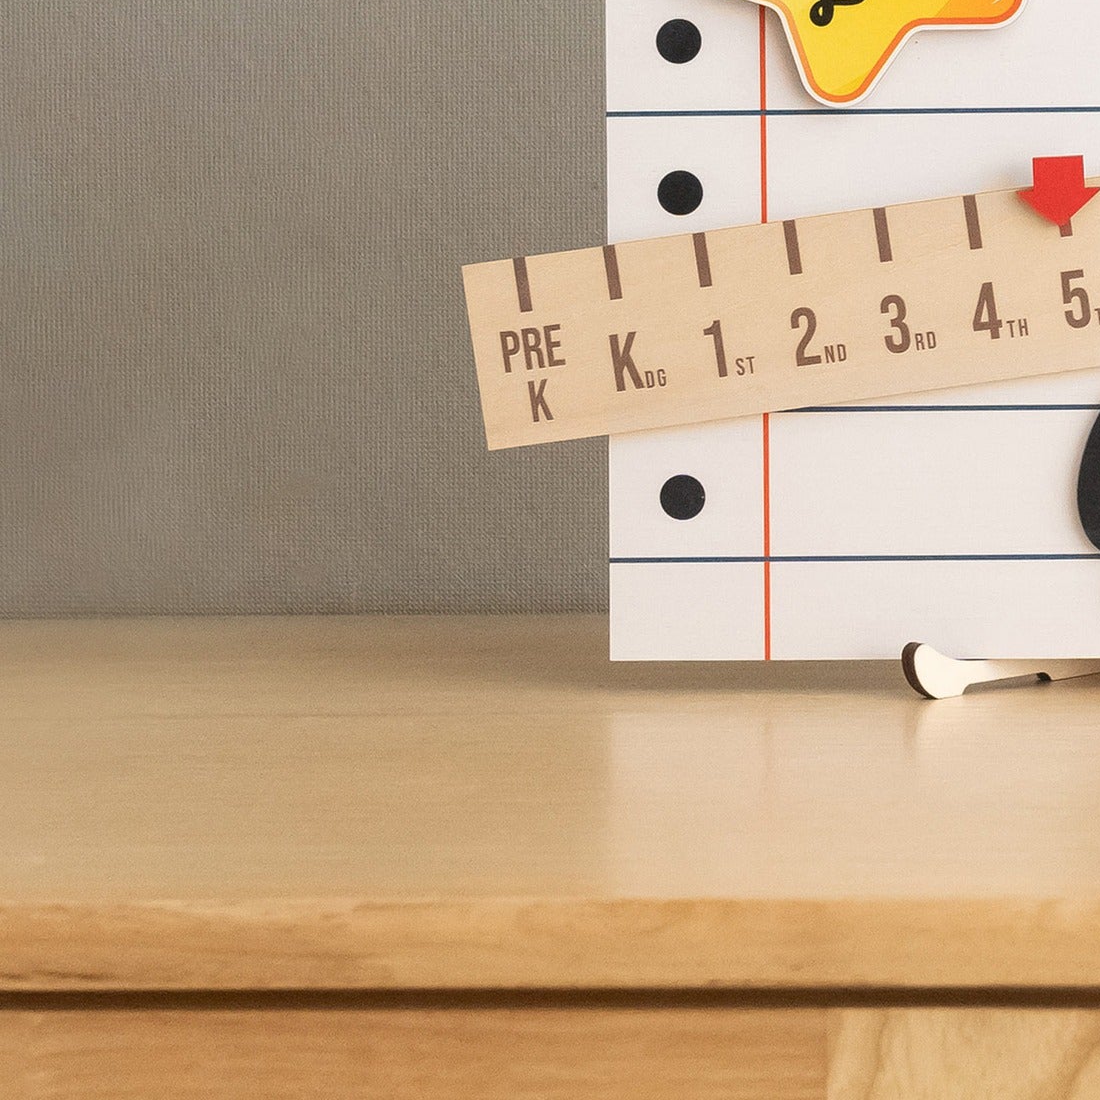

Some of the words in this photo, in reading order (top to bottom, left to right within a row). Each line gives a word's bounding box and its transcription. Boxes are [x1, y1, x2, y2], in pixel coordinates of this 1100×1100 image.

[500, 323, 567, 374] PRE
[702, 320, 756, 378] 1ST
[790, 307, 847, 367] 2ND
[879, 294, 937, 354] 3RD
[972, 282, 1029, 340] 4TH
[527, 378, 555, 423] K
